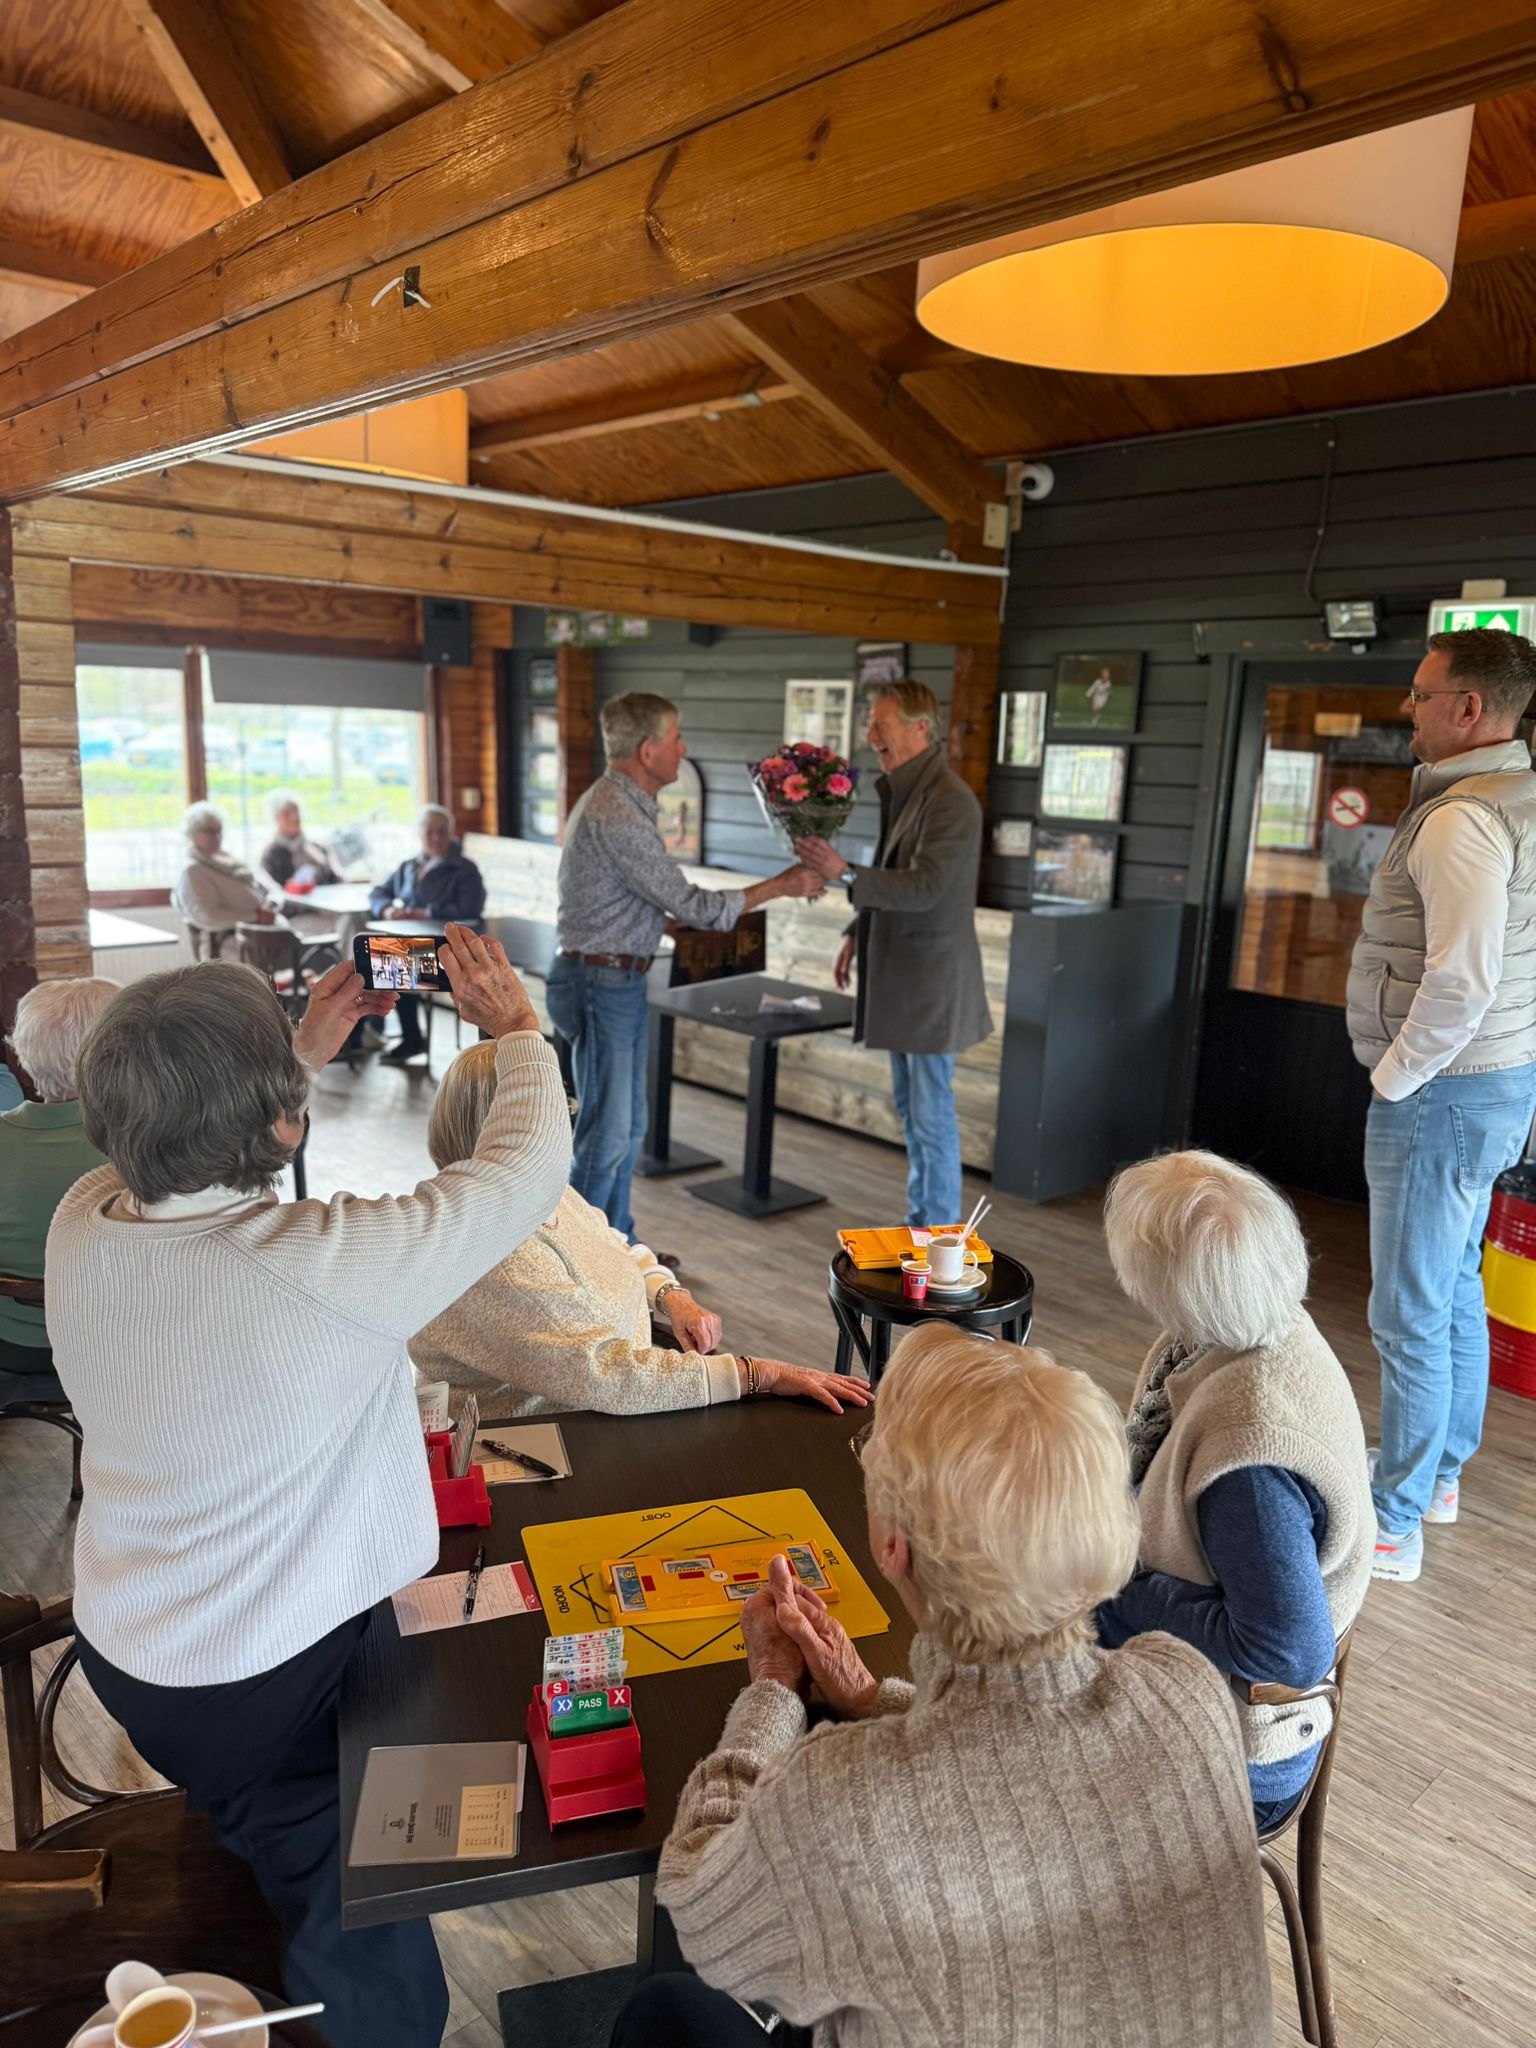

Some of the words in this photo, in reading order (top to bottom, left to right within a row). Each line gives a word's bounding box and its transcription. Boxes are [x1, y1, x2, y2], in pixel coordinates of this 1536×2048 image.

[641, 1512, 671, 1522] OOST
[823, 1549, 840, 1566] ZUID
[552, 1585, 570, 1613] NOORD
[733, 1643, 745, 1651] W
[553, 1682, 562, 1694] S
[578, 1697, 602, 1709] PASS
[613, 1689, 626, 1705] X
